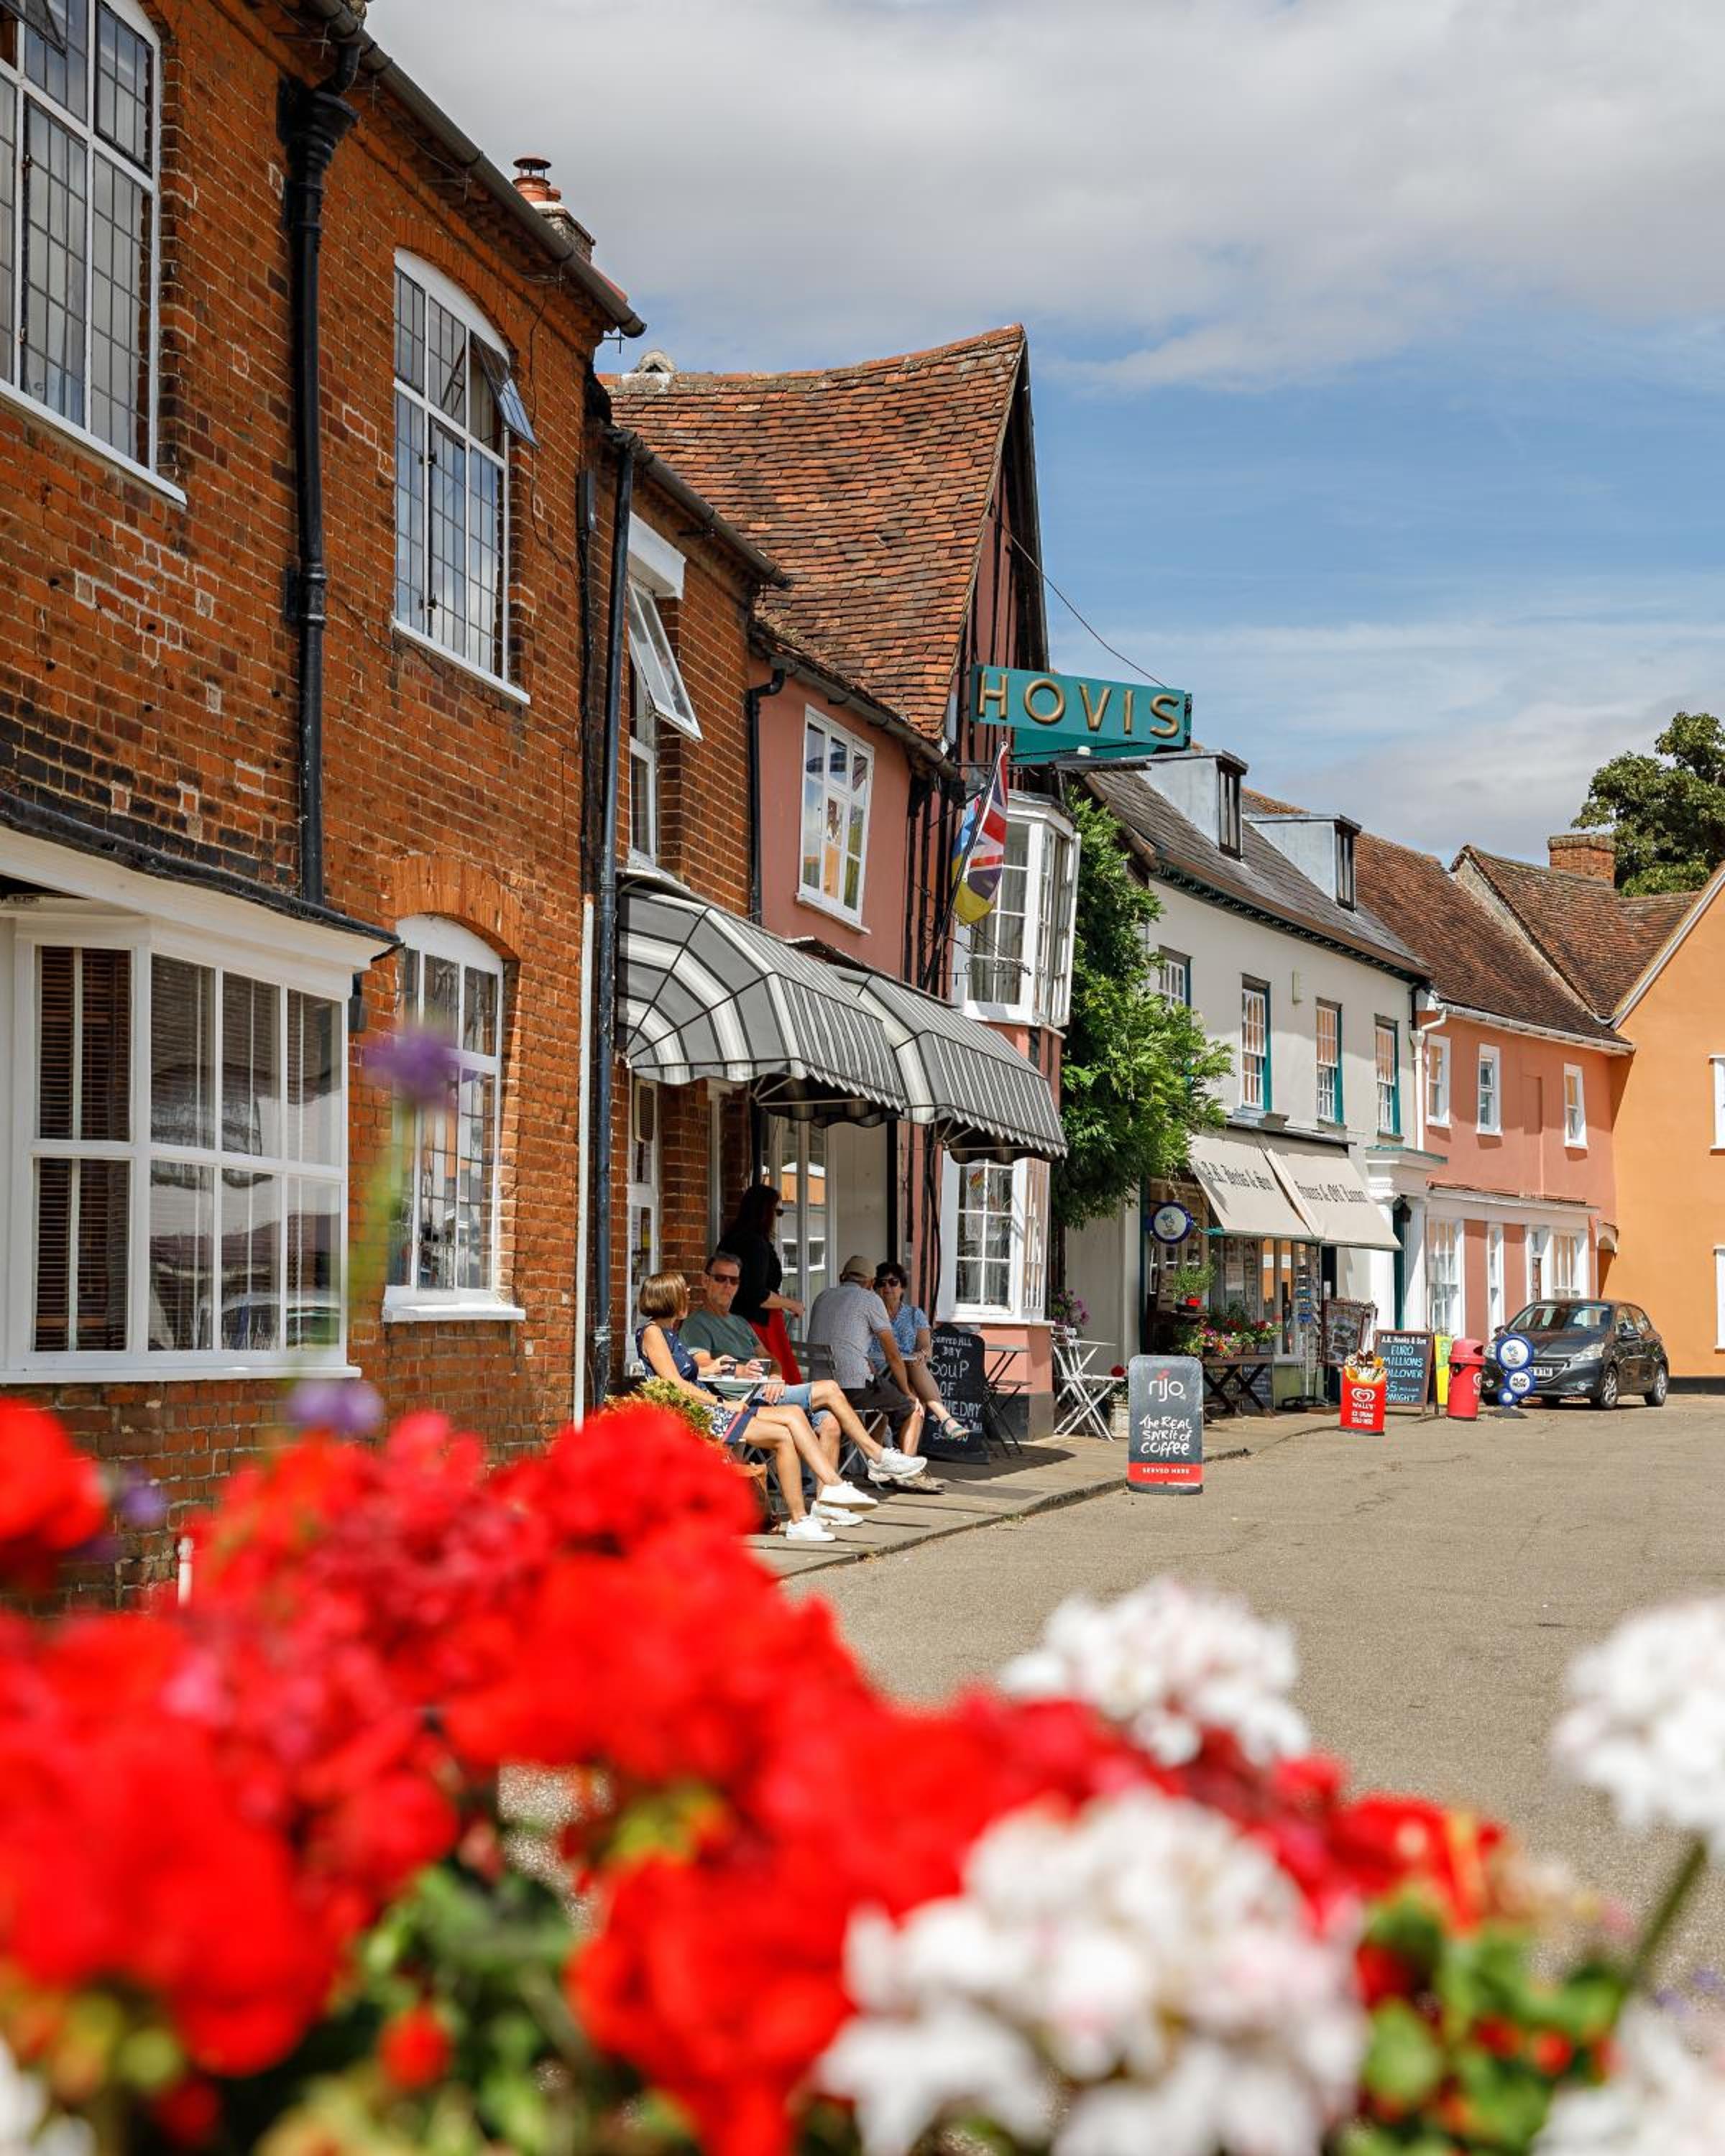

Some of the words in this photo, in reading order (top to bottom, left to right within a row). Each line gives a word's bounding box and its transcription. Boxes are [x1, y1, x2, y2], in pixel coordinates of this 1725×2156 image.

[978, 672, 1179, 738] HOVIS
[958, 1337, 972, 1346] ALL
[1391, 1345, 1414, 1355] EURO
[930, 1355, 970, 1379] SOUP
[1383, 1357, 1423, 1367] MILLIONS
[939, 1381, 956, 1397] OF
[1149, 1378, 1184, 1402] rijo
[960, 1401, 982, 1416] DAY
[1139, 1414, 1159, 1429] The
[1161, 1416, 1192, 1429] REAL
[1179, 1429, 1193, 1442] of
